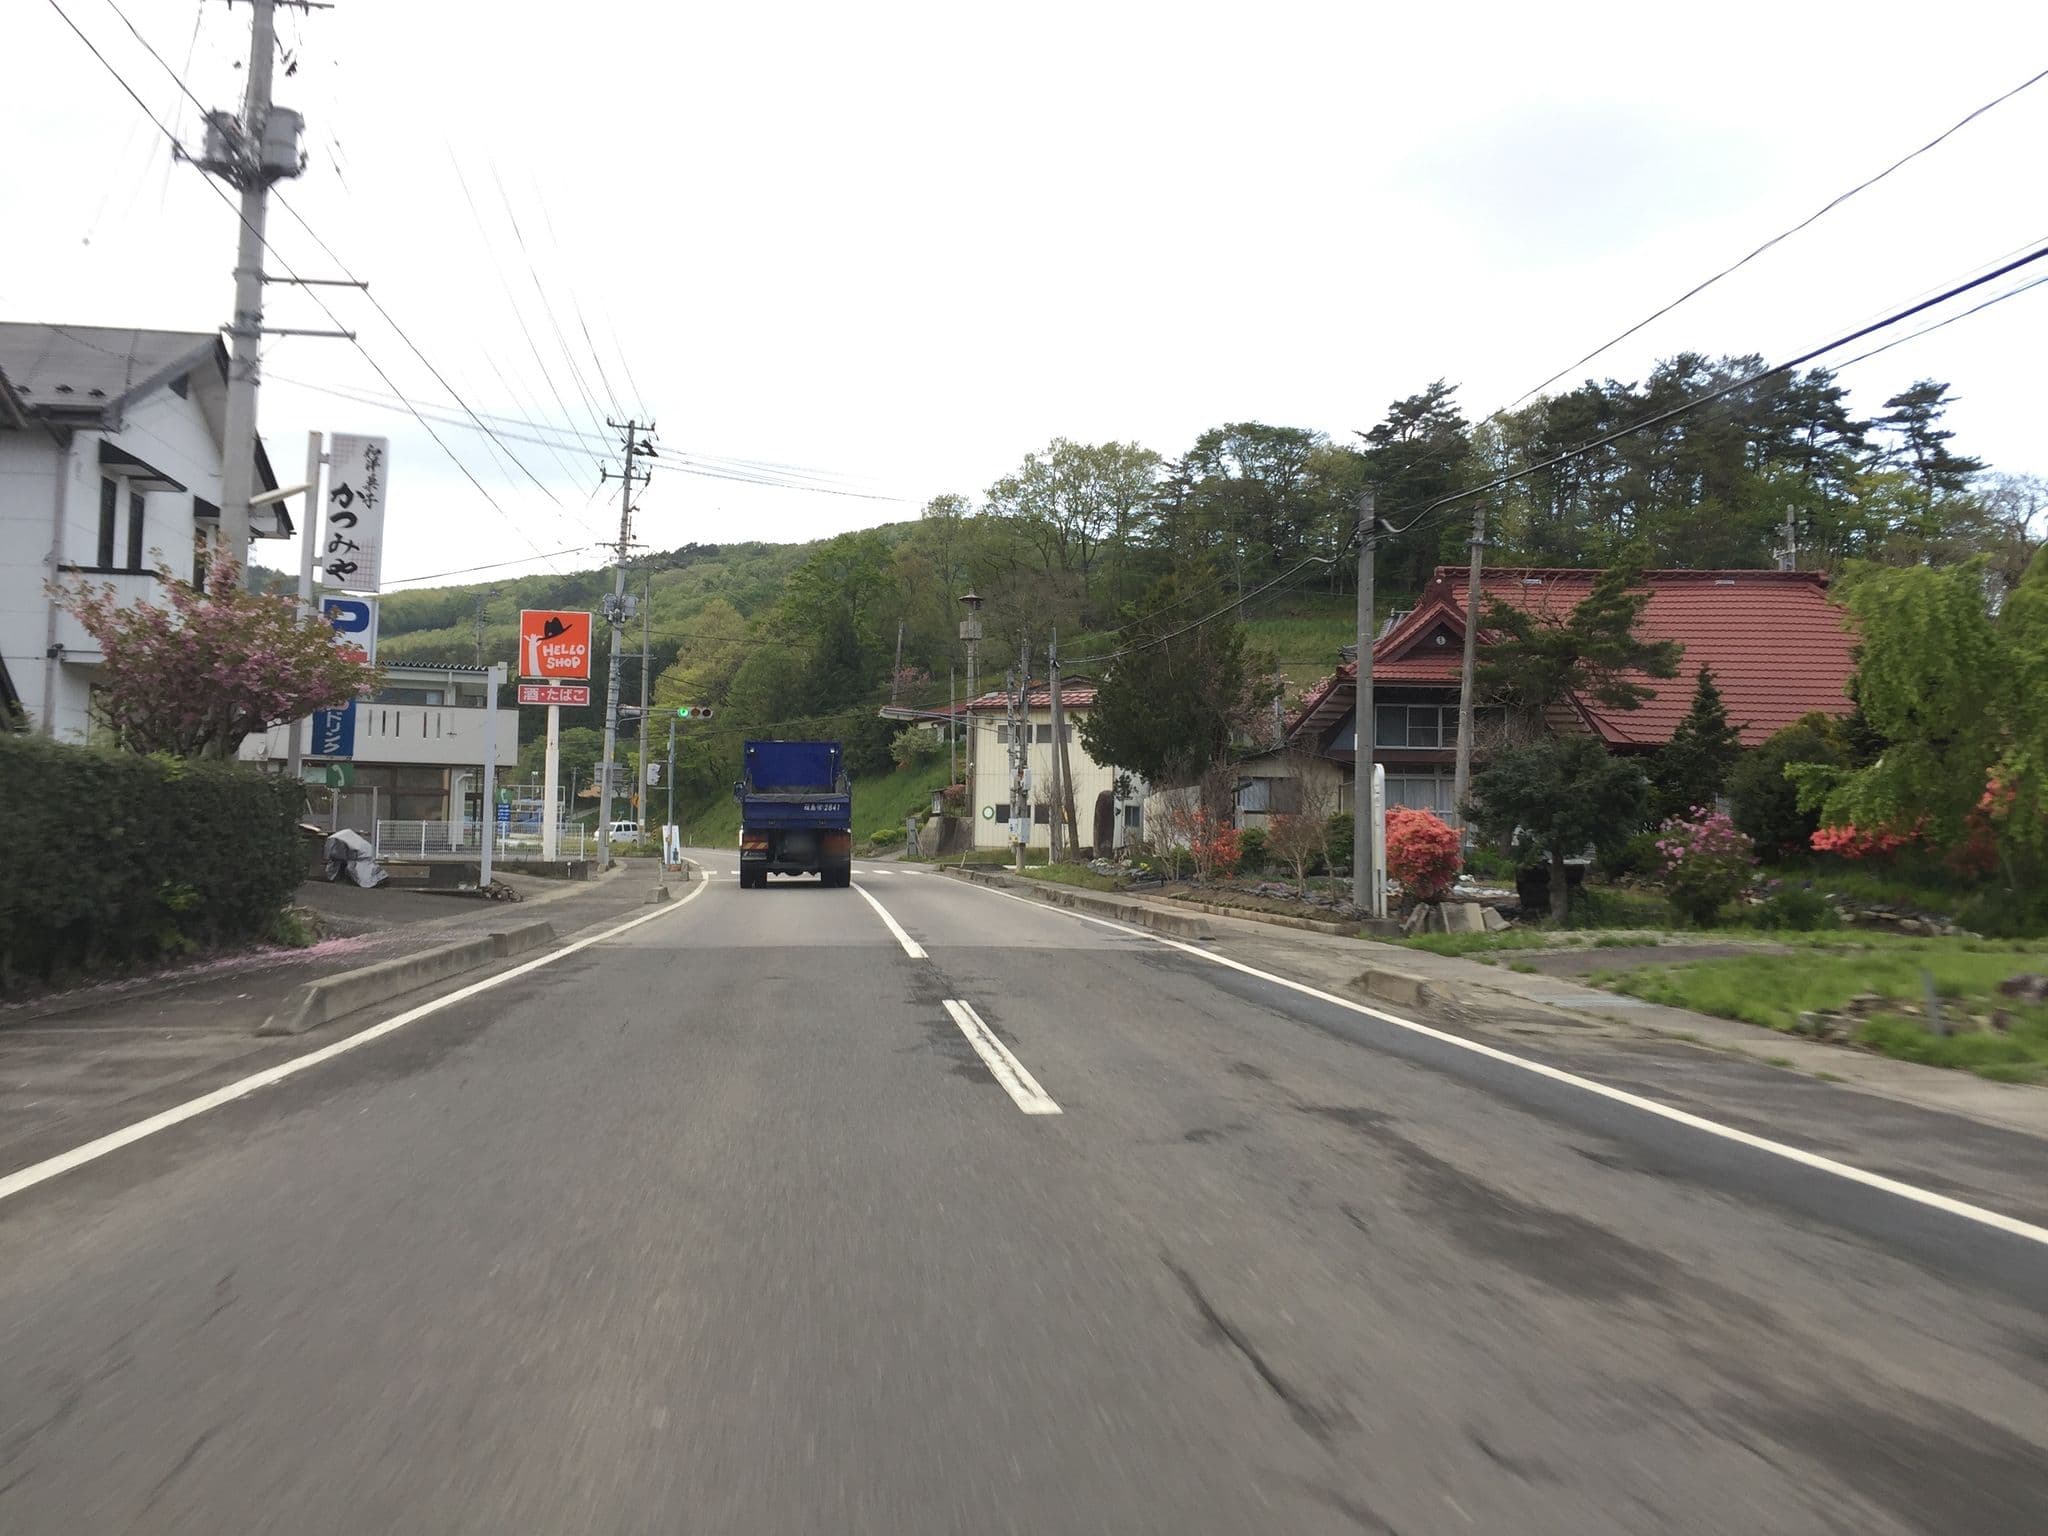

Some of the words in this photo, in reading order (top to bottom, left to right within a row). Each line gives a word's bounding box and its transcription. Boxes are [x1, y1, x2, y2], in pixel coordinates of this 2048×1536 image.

[326, 482, 365, 582] かつみや
[324, 599, 370, 643] P
[542, 643, 586, 656] HELLO
[546, 656, 581, 669] SHOP
[523, 687, 585, 701] 酒・たばこ
